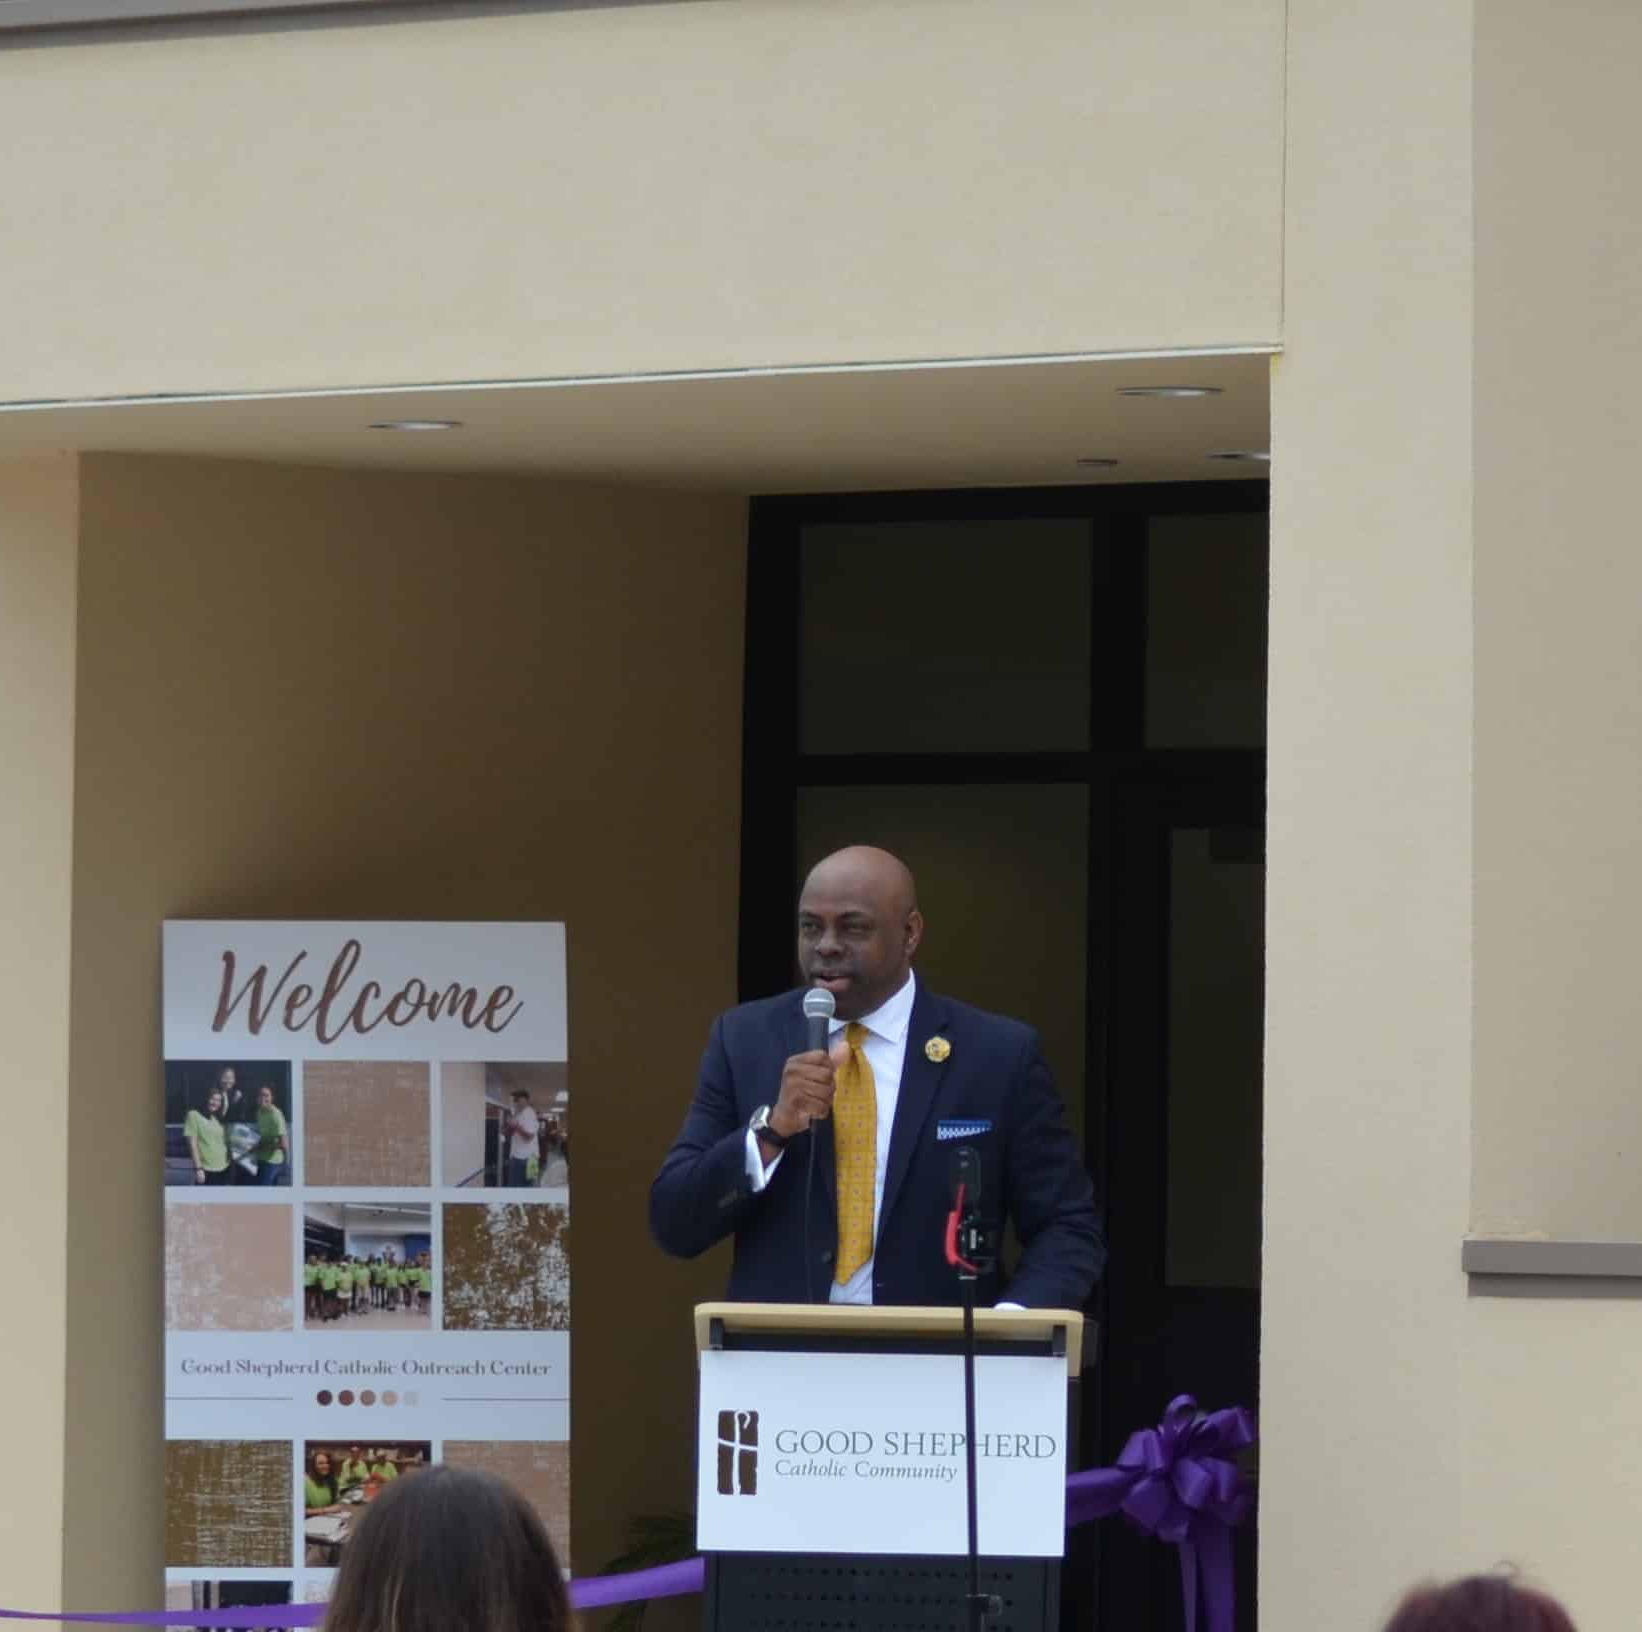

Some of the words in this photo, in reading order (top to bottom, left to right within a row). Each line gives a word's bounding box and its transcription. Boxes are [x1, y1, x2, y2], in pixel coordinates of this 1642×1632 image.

[211, 938, 525, 1045] Welcome
[180, 1358, 231, 1374] Good
[235, 1359, 320, 1378] Shepherd
[323, 1359, 398, 1375] Catholic
[401, 1359, 486, 1376] Outreach
[489, 1359, 552, 1376] Center
[775, 1429, 873, 1455] GOOD
[884, 1430, 1057, 1459] SHEPHERD
[774, 1458, 847, 1478] Catholic
[854, 1460, 958, 1482] Community
